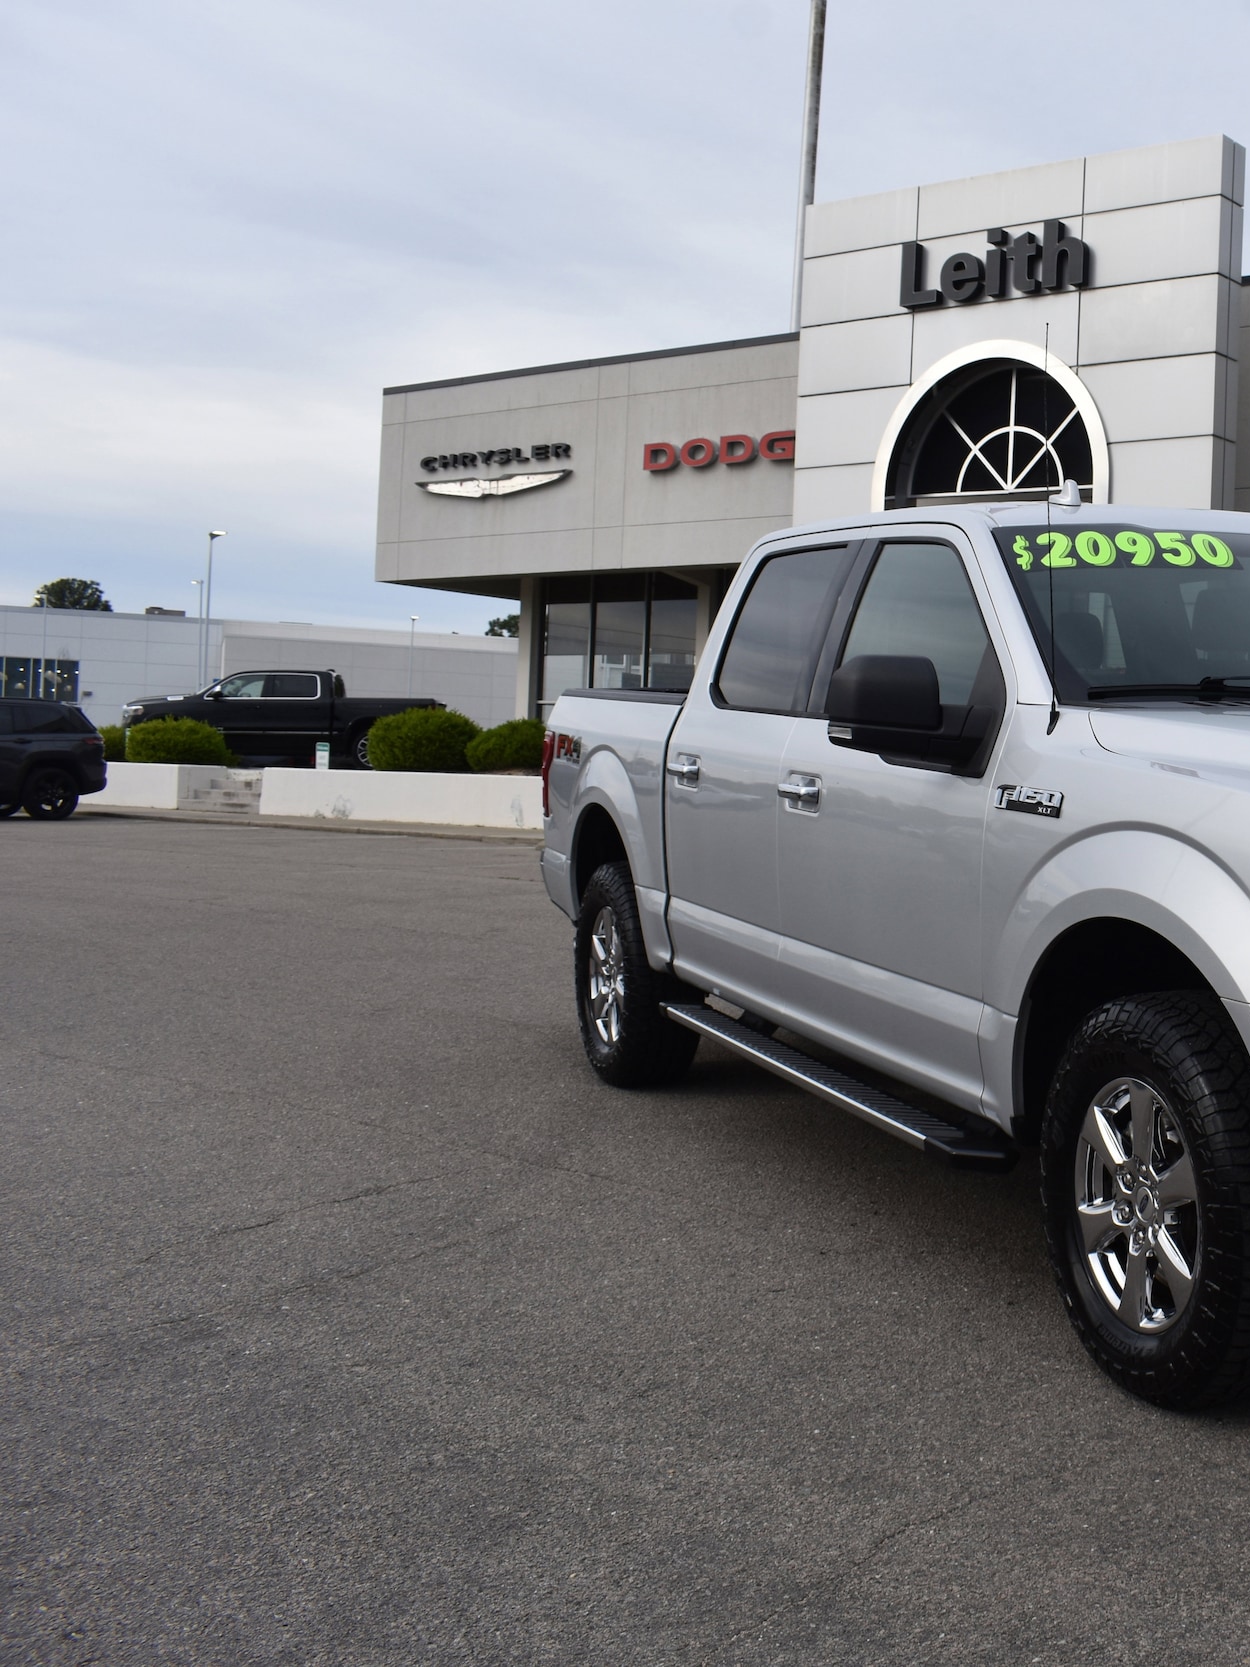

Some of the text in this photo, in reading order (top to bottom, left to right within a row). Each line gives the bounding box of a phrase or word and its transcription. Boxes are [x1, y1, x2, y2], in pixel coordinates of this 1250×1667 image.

[899, 219, 1091, 311] Leith
[420, 442, 572, 473] CHRYSLER
[643, 430, 796, 472] DODG
[1012, 530, 1235, 571] $20950
[556, 733, 583, 759] FX4
[1037, 806, 1052, 814] XLT
